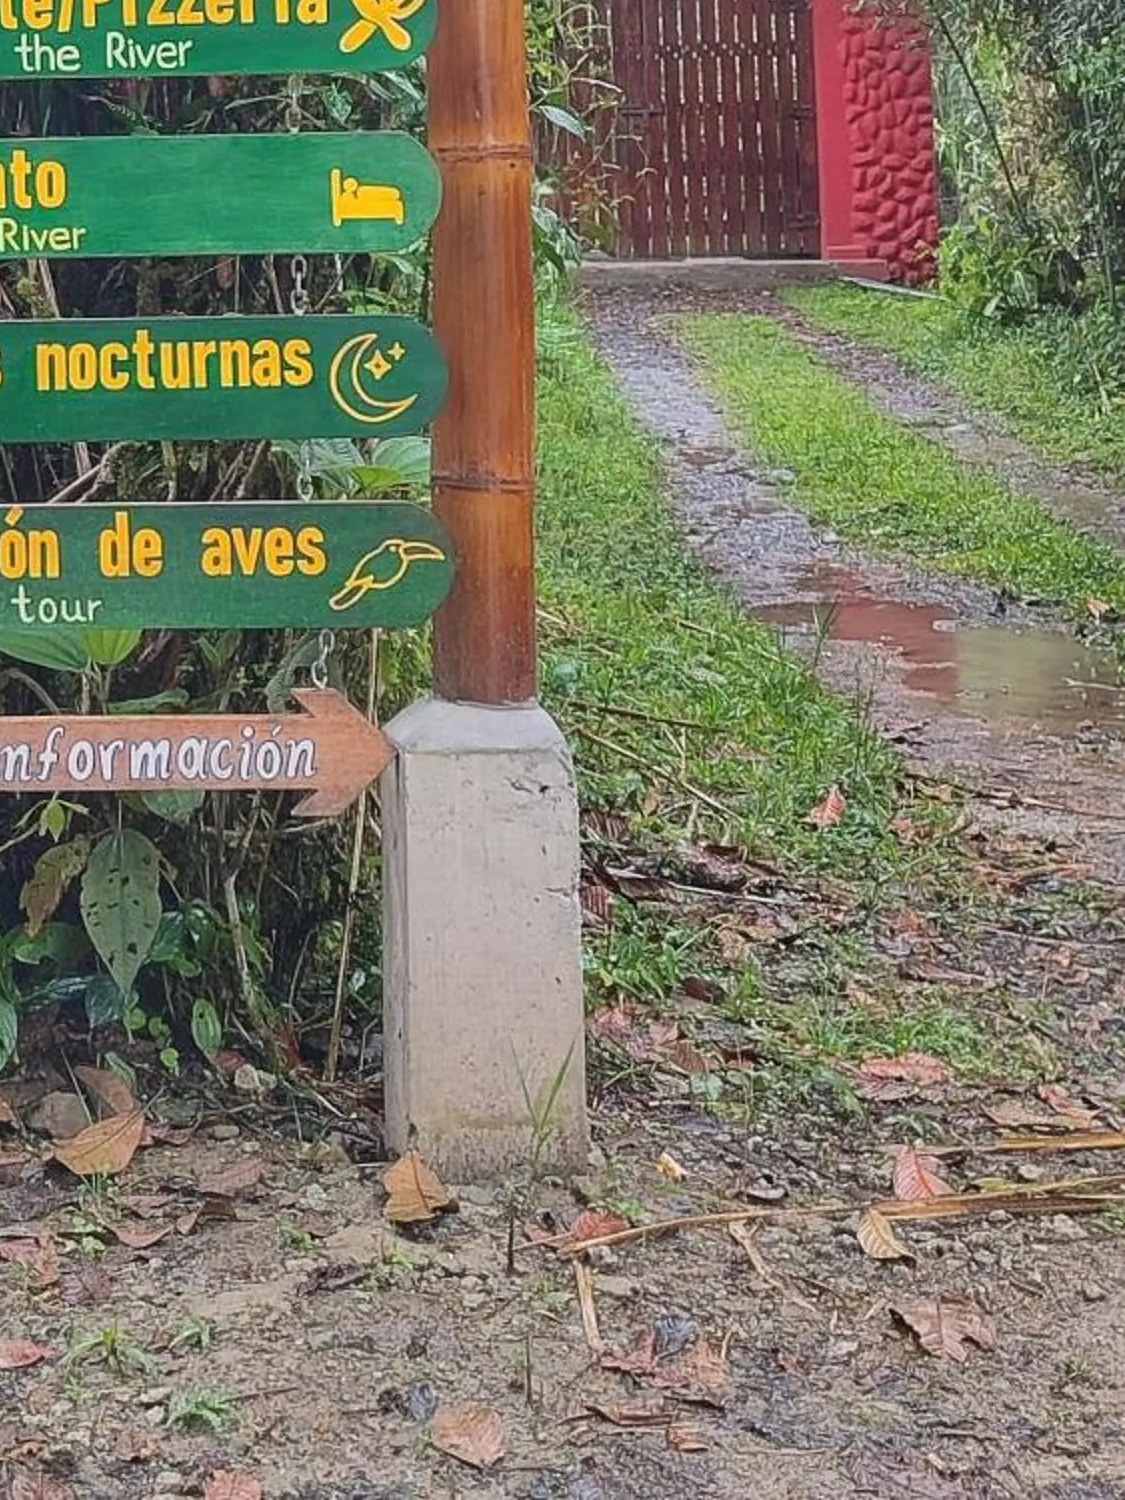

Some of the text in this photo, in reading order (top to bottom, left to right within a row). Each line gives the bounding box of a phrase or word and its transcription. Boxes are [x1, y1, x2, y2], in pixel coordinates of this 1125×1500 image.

[14, 36, 80, 72] the
[105, 32, 192, 69] River
[36, 329, 314, 391] nocturnas
[98, 510, 164, 577] de
[201, 522, 326, 577] aves
[12, 589, 102, 623] tour
